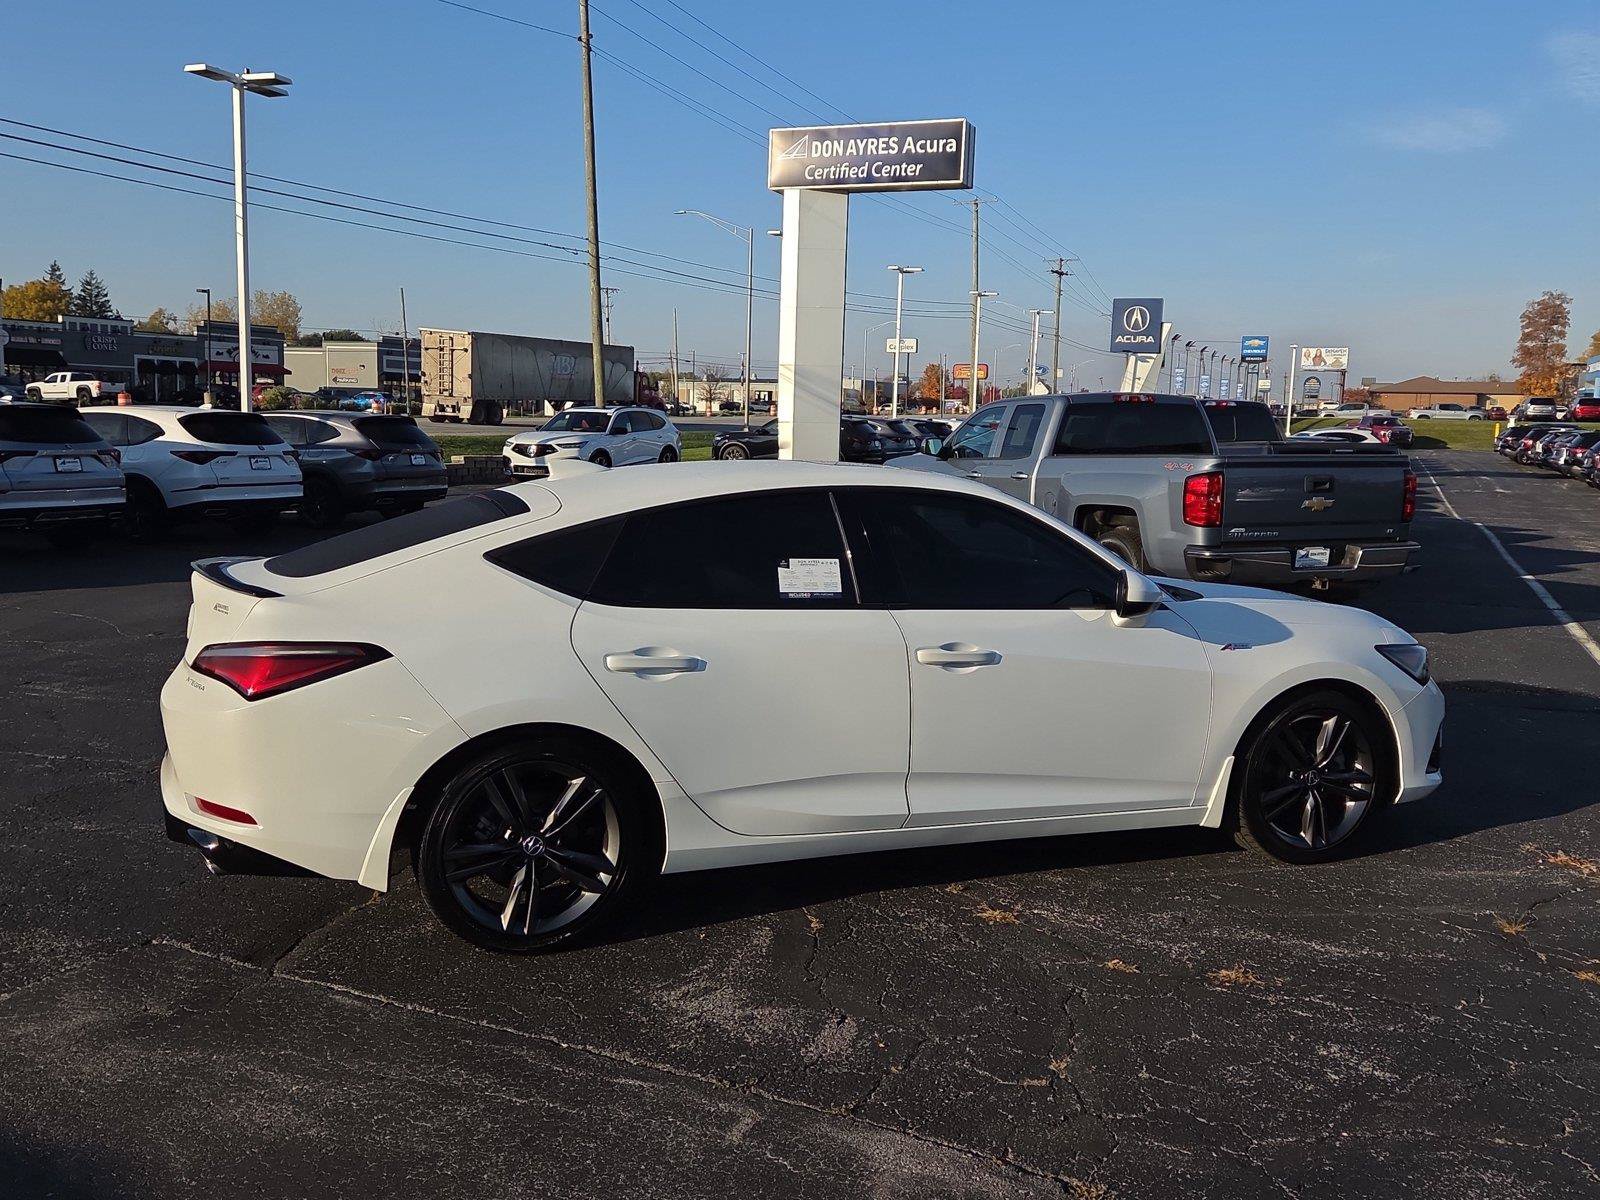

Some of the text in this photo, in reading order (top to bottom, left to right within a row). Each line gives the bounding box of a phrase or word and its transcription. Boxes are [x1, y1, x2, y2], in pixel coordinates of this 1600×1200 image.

[811, 136, 957, 158] DON AYRES Acura
[804, 161, 924, 180] Certified Center
[92, 335, 118, 344] CRISPY
[1115, 335, 1155, 343] ACURA
[92, 343, 118, 351] CONES
[888, 343, 914, 351] Caplex
